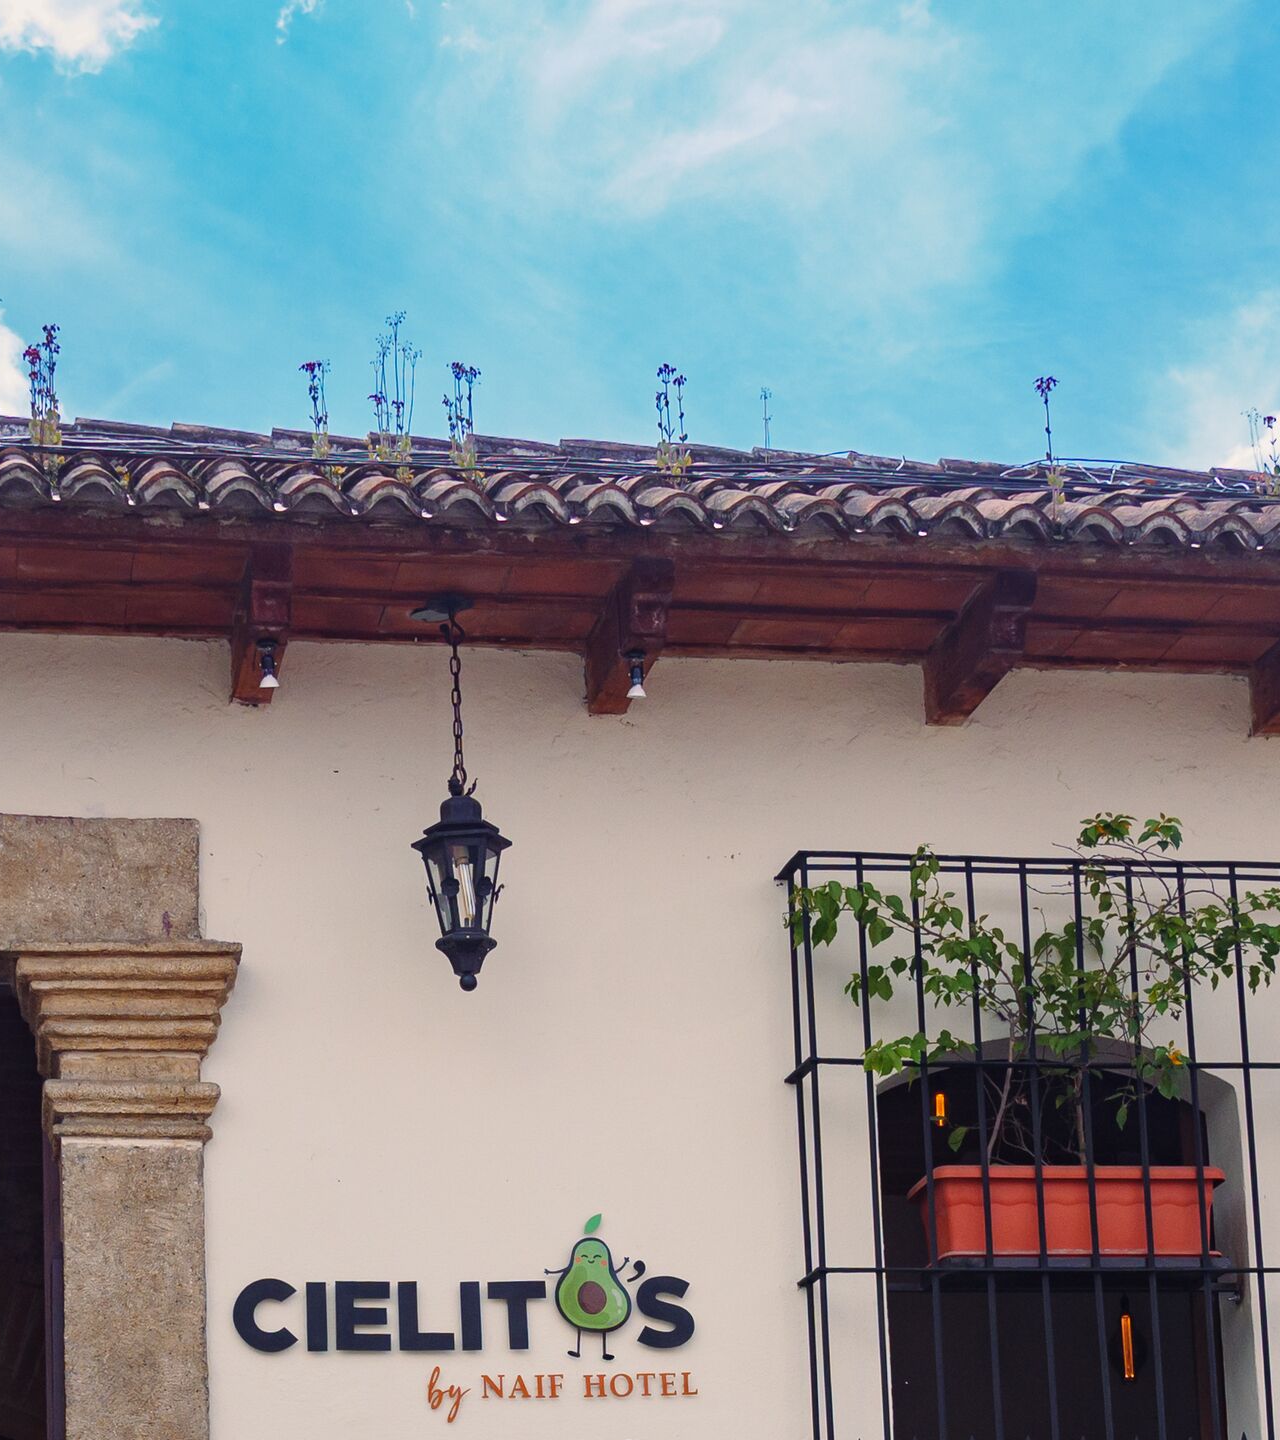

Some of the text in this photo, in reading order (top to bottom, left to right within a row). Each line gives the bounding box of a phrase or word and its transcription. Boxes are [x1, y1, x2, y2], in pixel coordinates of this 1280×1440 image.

[426, 1365, 699, 1424] by NAIF HOTEL
